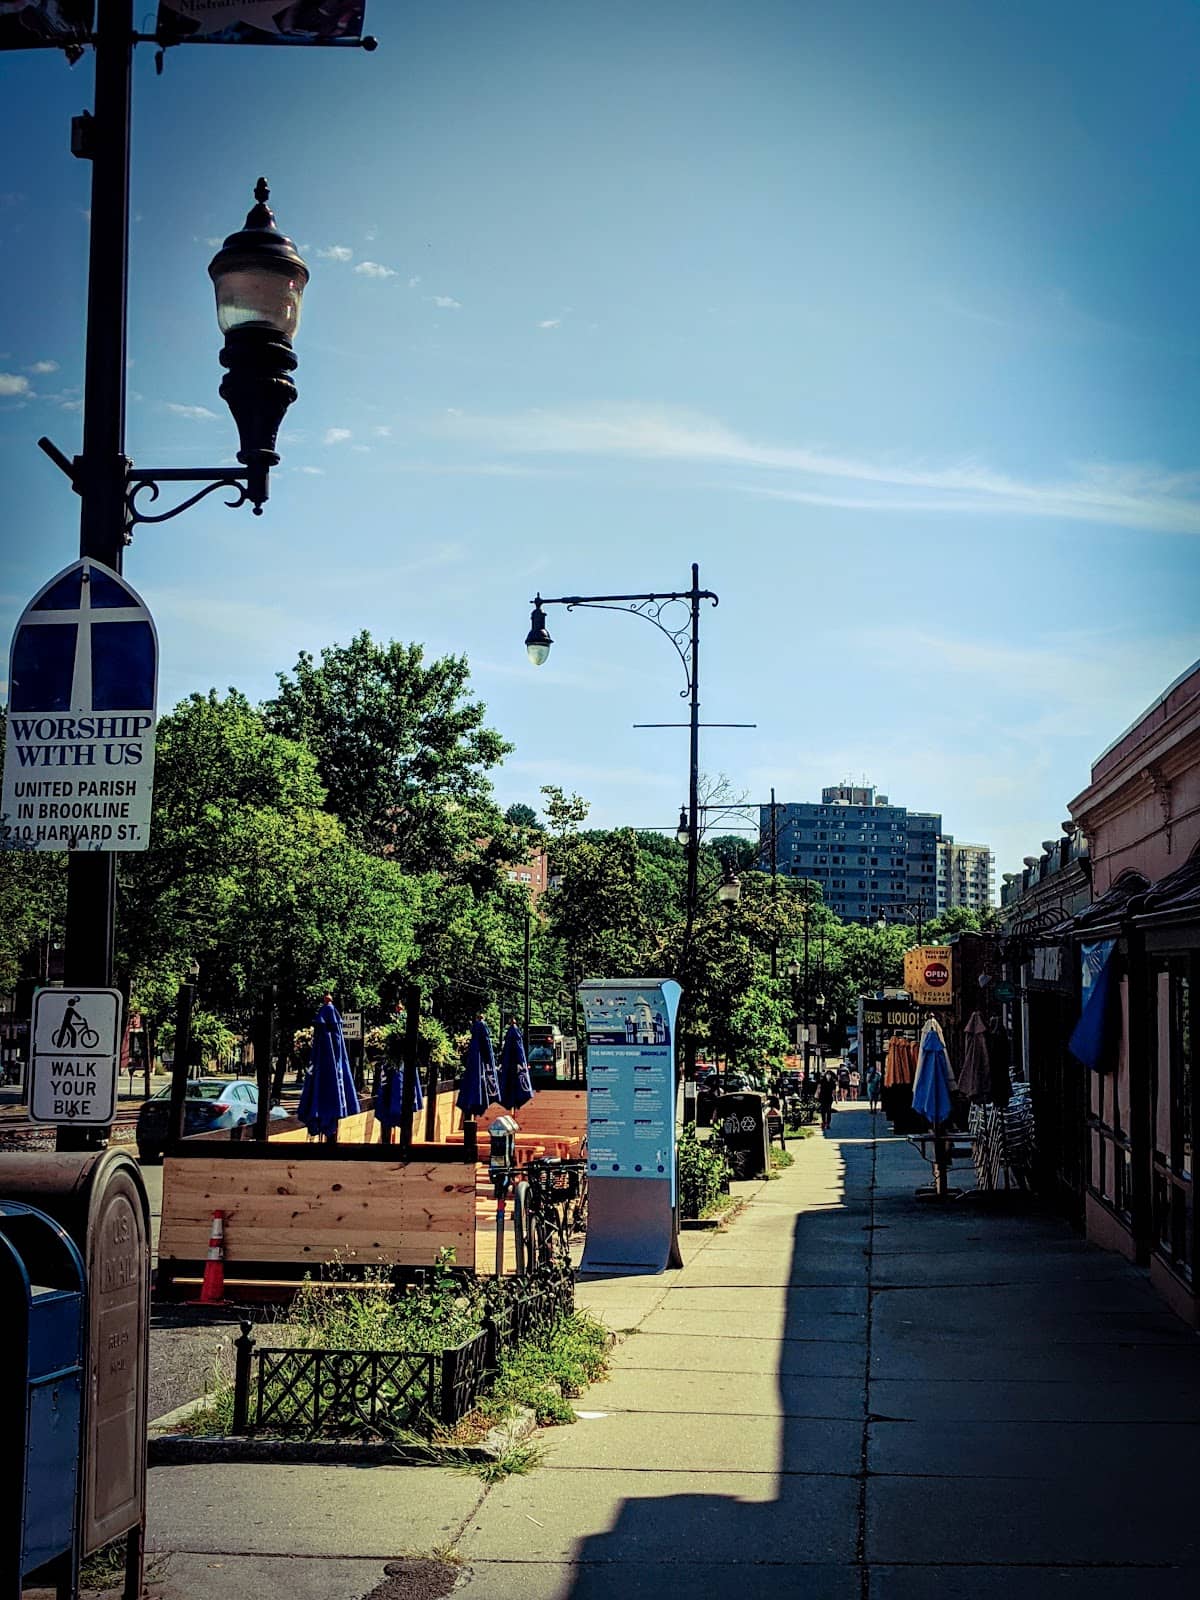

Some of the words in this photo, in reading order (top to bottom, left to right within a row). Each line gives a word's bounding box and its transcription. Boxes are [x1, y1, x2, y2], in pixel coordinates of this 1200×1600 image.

[10, 717, 152, 740] WORSHIP
[16, 744, 97, 767] WITH
[104, 743, 143, 765] US
[14, 782, 73, 797] UNITED
[78, 781, 137, 796] PARISH
[18, 804, 34, 819] IN
[39, 803, 130, 819] BROOKLINE
[3, 826, 32, 841] 210
[37, 825, 112, 841] HARVARD
[117, 825, 141, 841] ST.
[925, 970, 948, 978] OPEN
[51, 1061, 97, 1077] WALK
[50, 1080, 97, 1096] YOUR
[53, 1100, 91, 1115] BIKE
